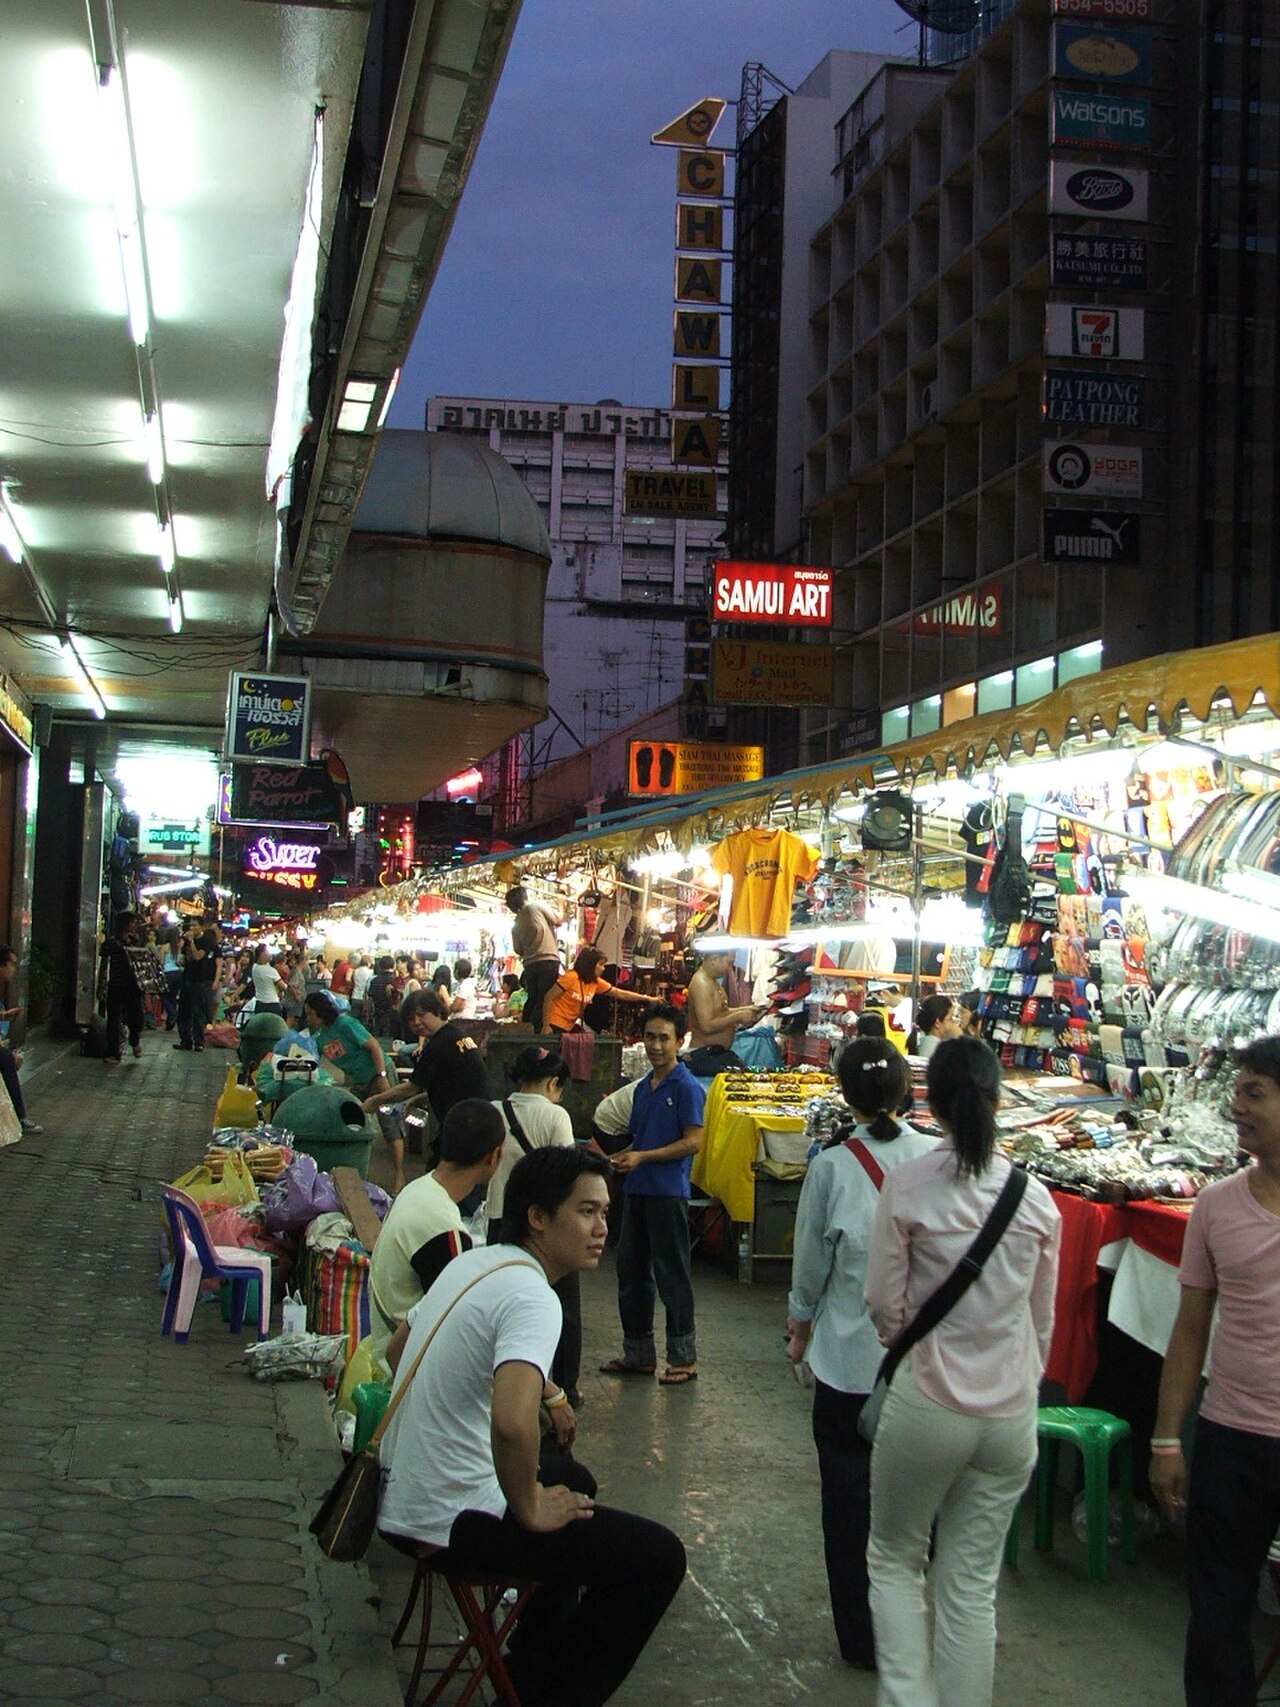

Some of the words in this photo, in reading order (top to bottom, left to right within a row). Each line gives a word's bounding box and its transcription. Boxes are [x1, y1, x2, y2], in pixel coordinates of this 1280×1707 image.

[1075, 176, 1124, 201] Boots
[1082, 314, 1110, 355] 7
[1049, 378, 1139, 405] PATPONG
[444, 404, 567, 432] อาคเนย์
[1048, 400, 1139, 425] LEATHER
[1095, 457, 1139, 471] YOGA
[631, 475, 712, 499] TRAVEL
[1054, 535, 1113, 559] PUMA
[717, 577, 784, 615] SAMUI
[789, 582, 830, 618] ART
[724, 752, 760, 763] MASSAGE
[252, 766, 304, 788] Red
[248, 785, 323, 807] Parrot
[144, 831, 170, 842] RUG
[250, 836, 321, 870] Super
